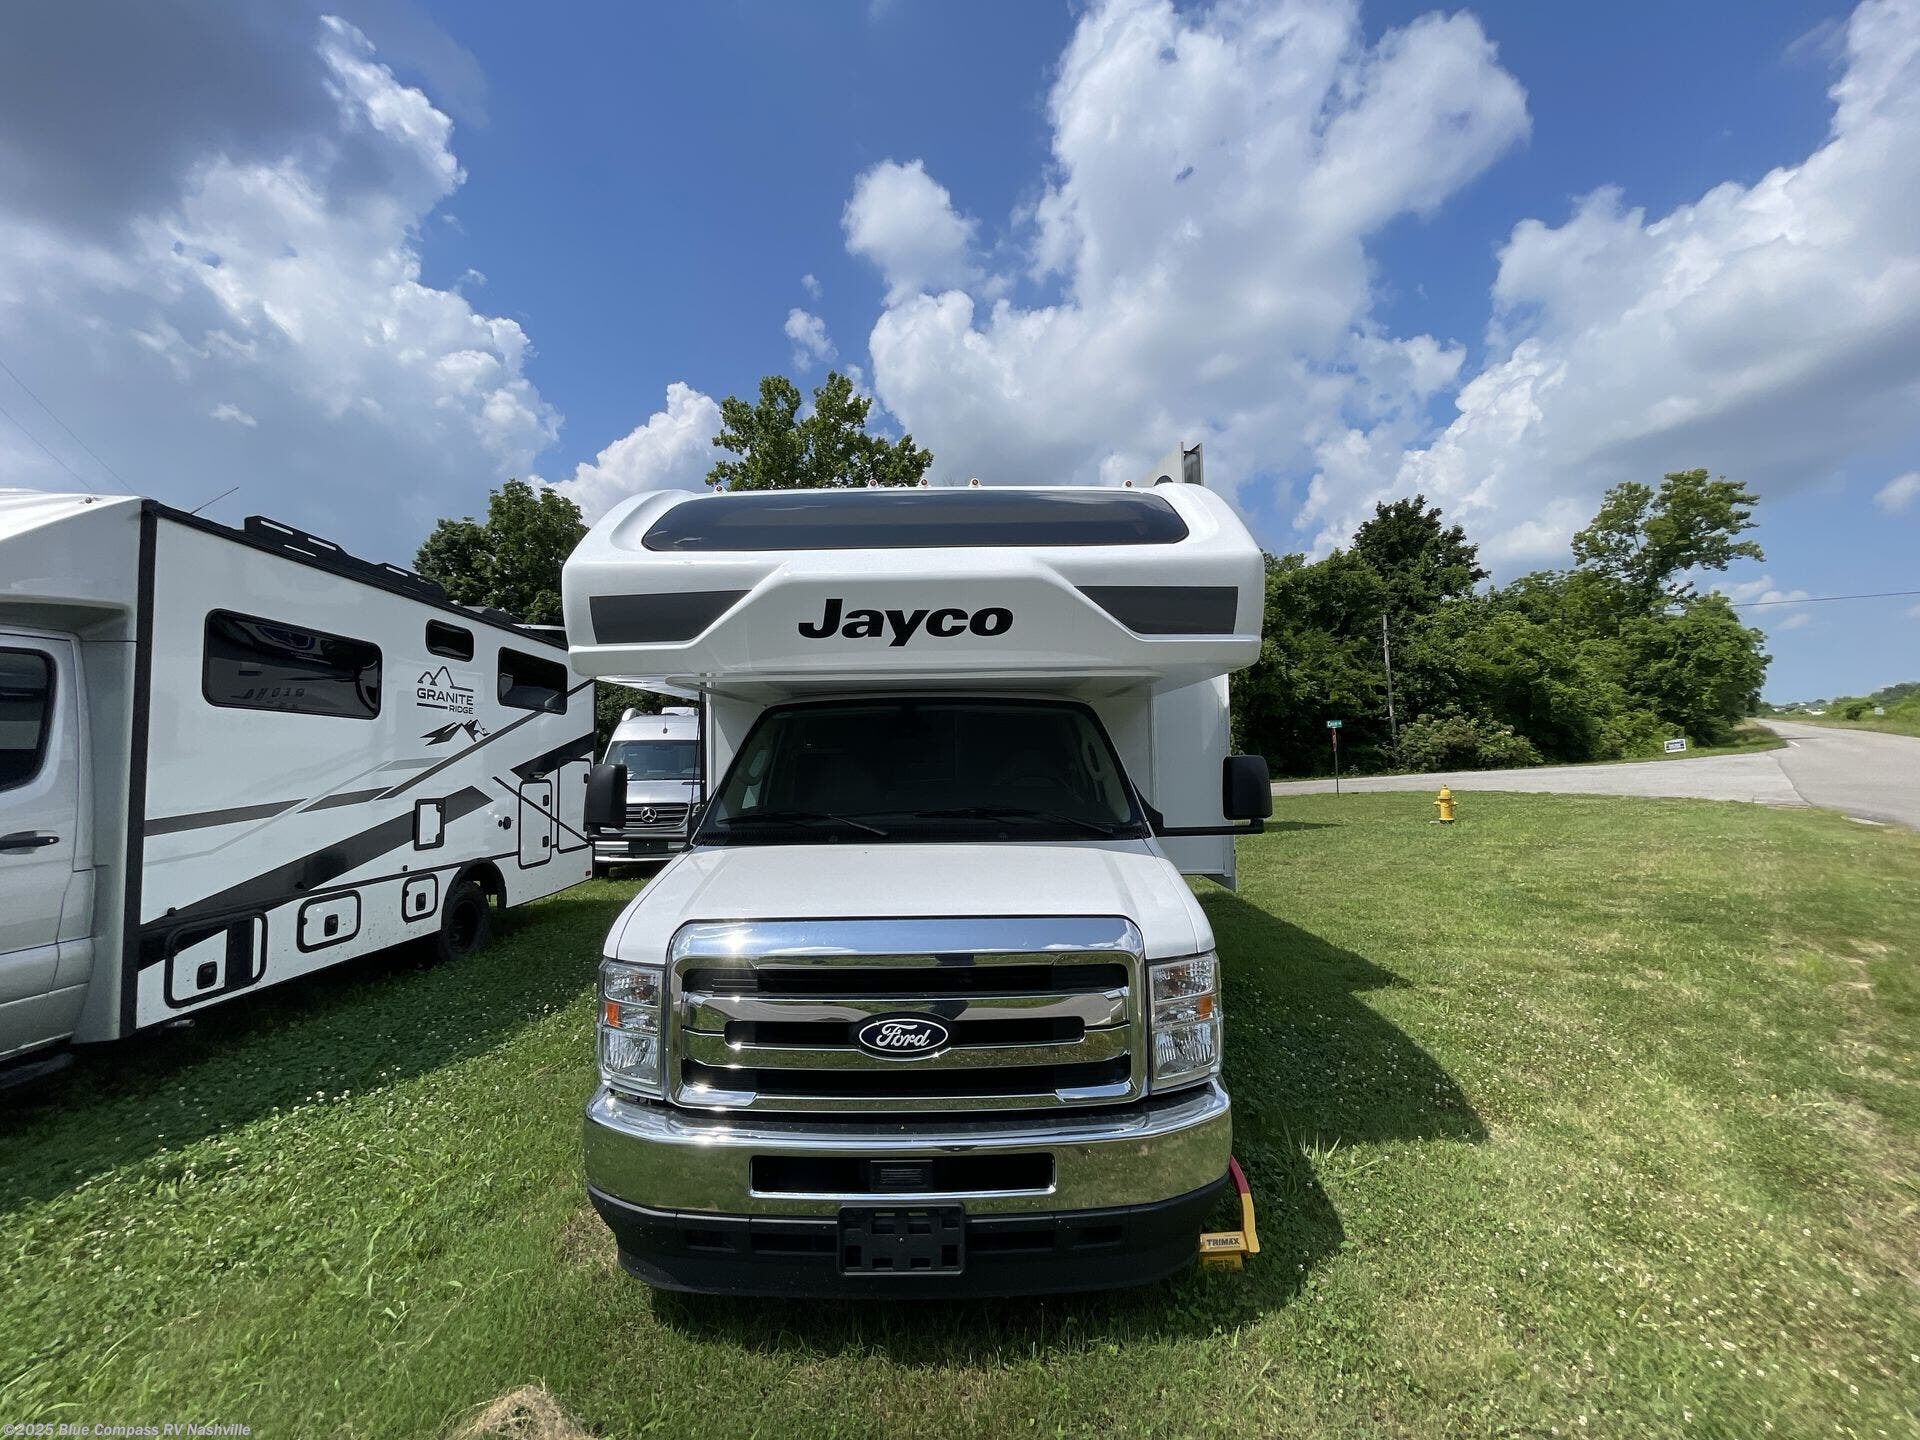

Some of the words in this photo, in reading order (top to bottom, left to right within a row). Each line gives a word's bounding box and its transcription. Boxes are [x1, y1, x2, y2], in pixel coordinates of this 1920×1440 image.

[798, 598, 1014, 647] Jayco
[416, 687, 474, 706] GRANITE
[449, 705, 474, 715] RIDGE
[876, 1023, 932, 1047] Ford
[1207, 1238, 1240, 1246] TRIMAX
